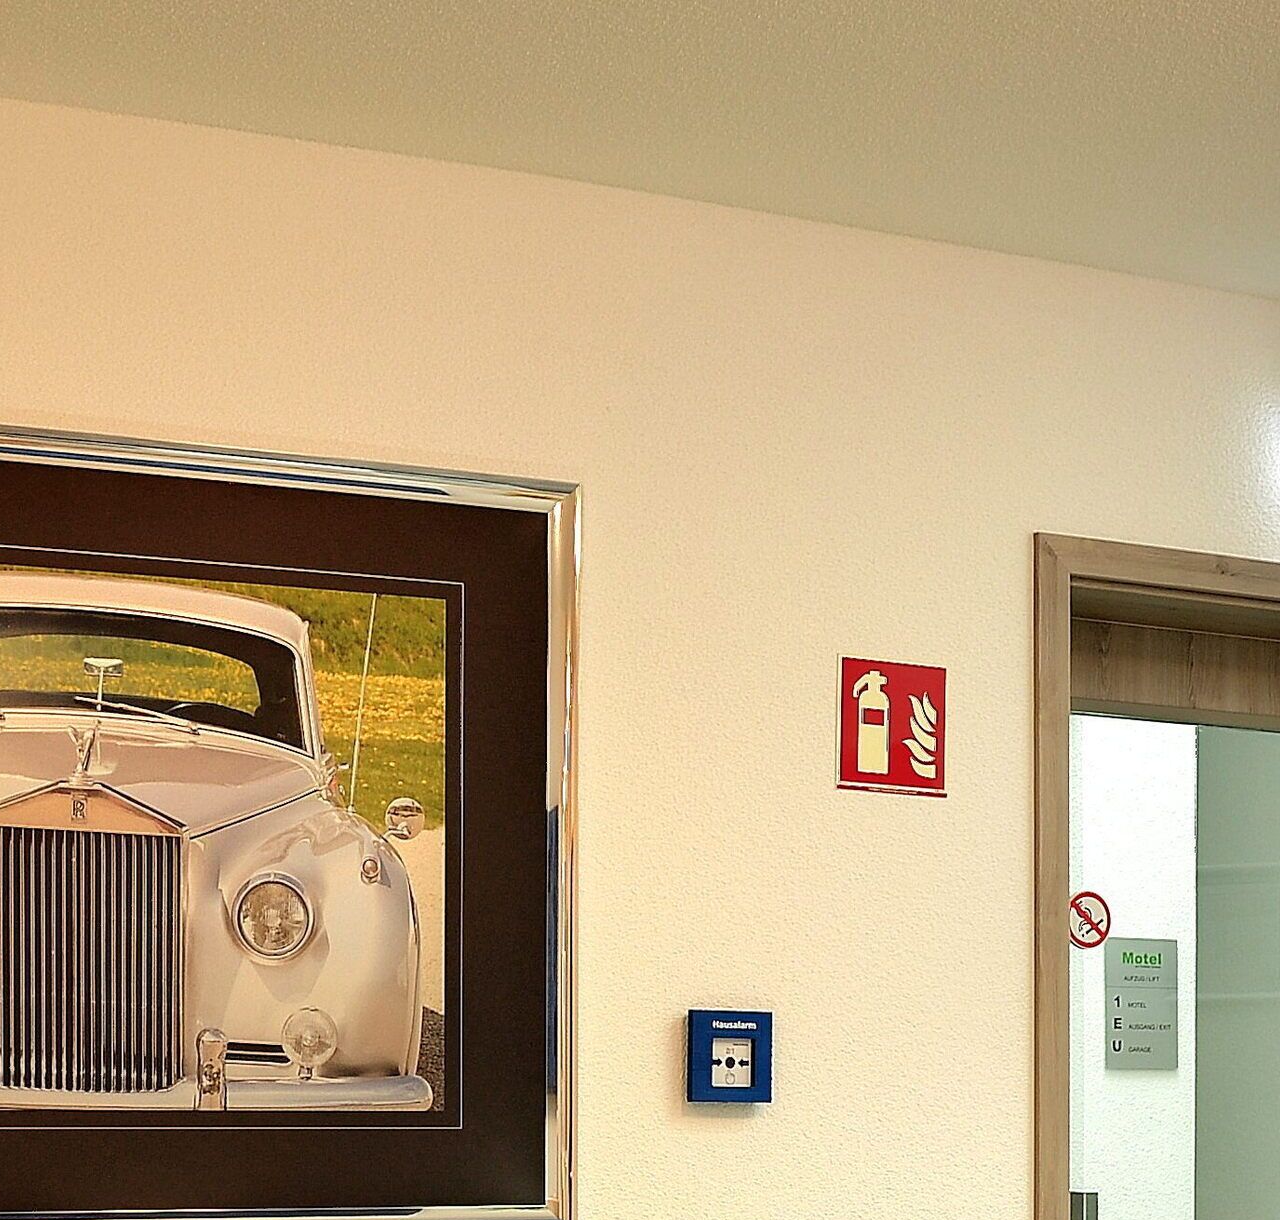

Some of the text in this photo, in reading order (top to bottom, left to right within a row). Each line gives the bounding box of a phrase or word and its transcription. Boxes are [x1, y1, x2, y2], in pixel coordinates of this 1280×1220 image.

[1122, 951, 1162, 965] Motel
[1114, 995, 1120, 1007] 1
[712, 1019, 757, 1030] Hausalarm
[1113, 1017, 1122, 1029] E
[1112, 1040, 1122, 1052] U
